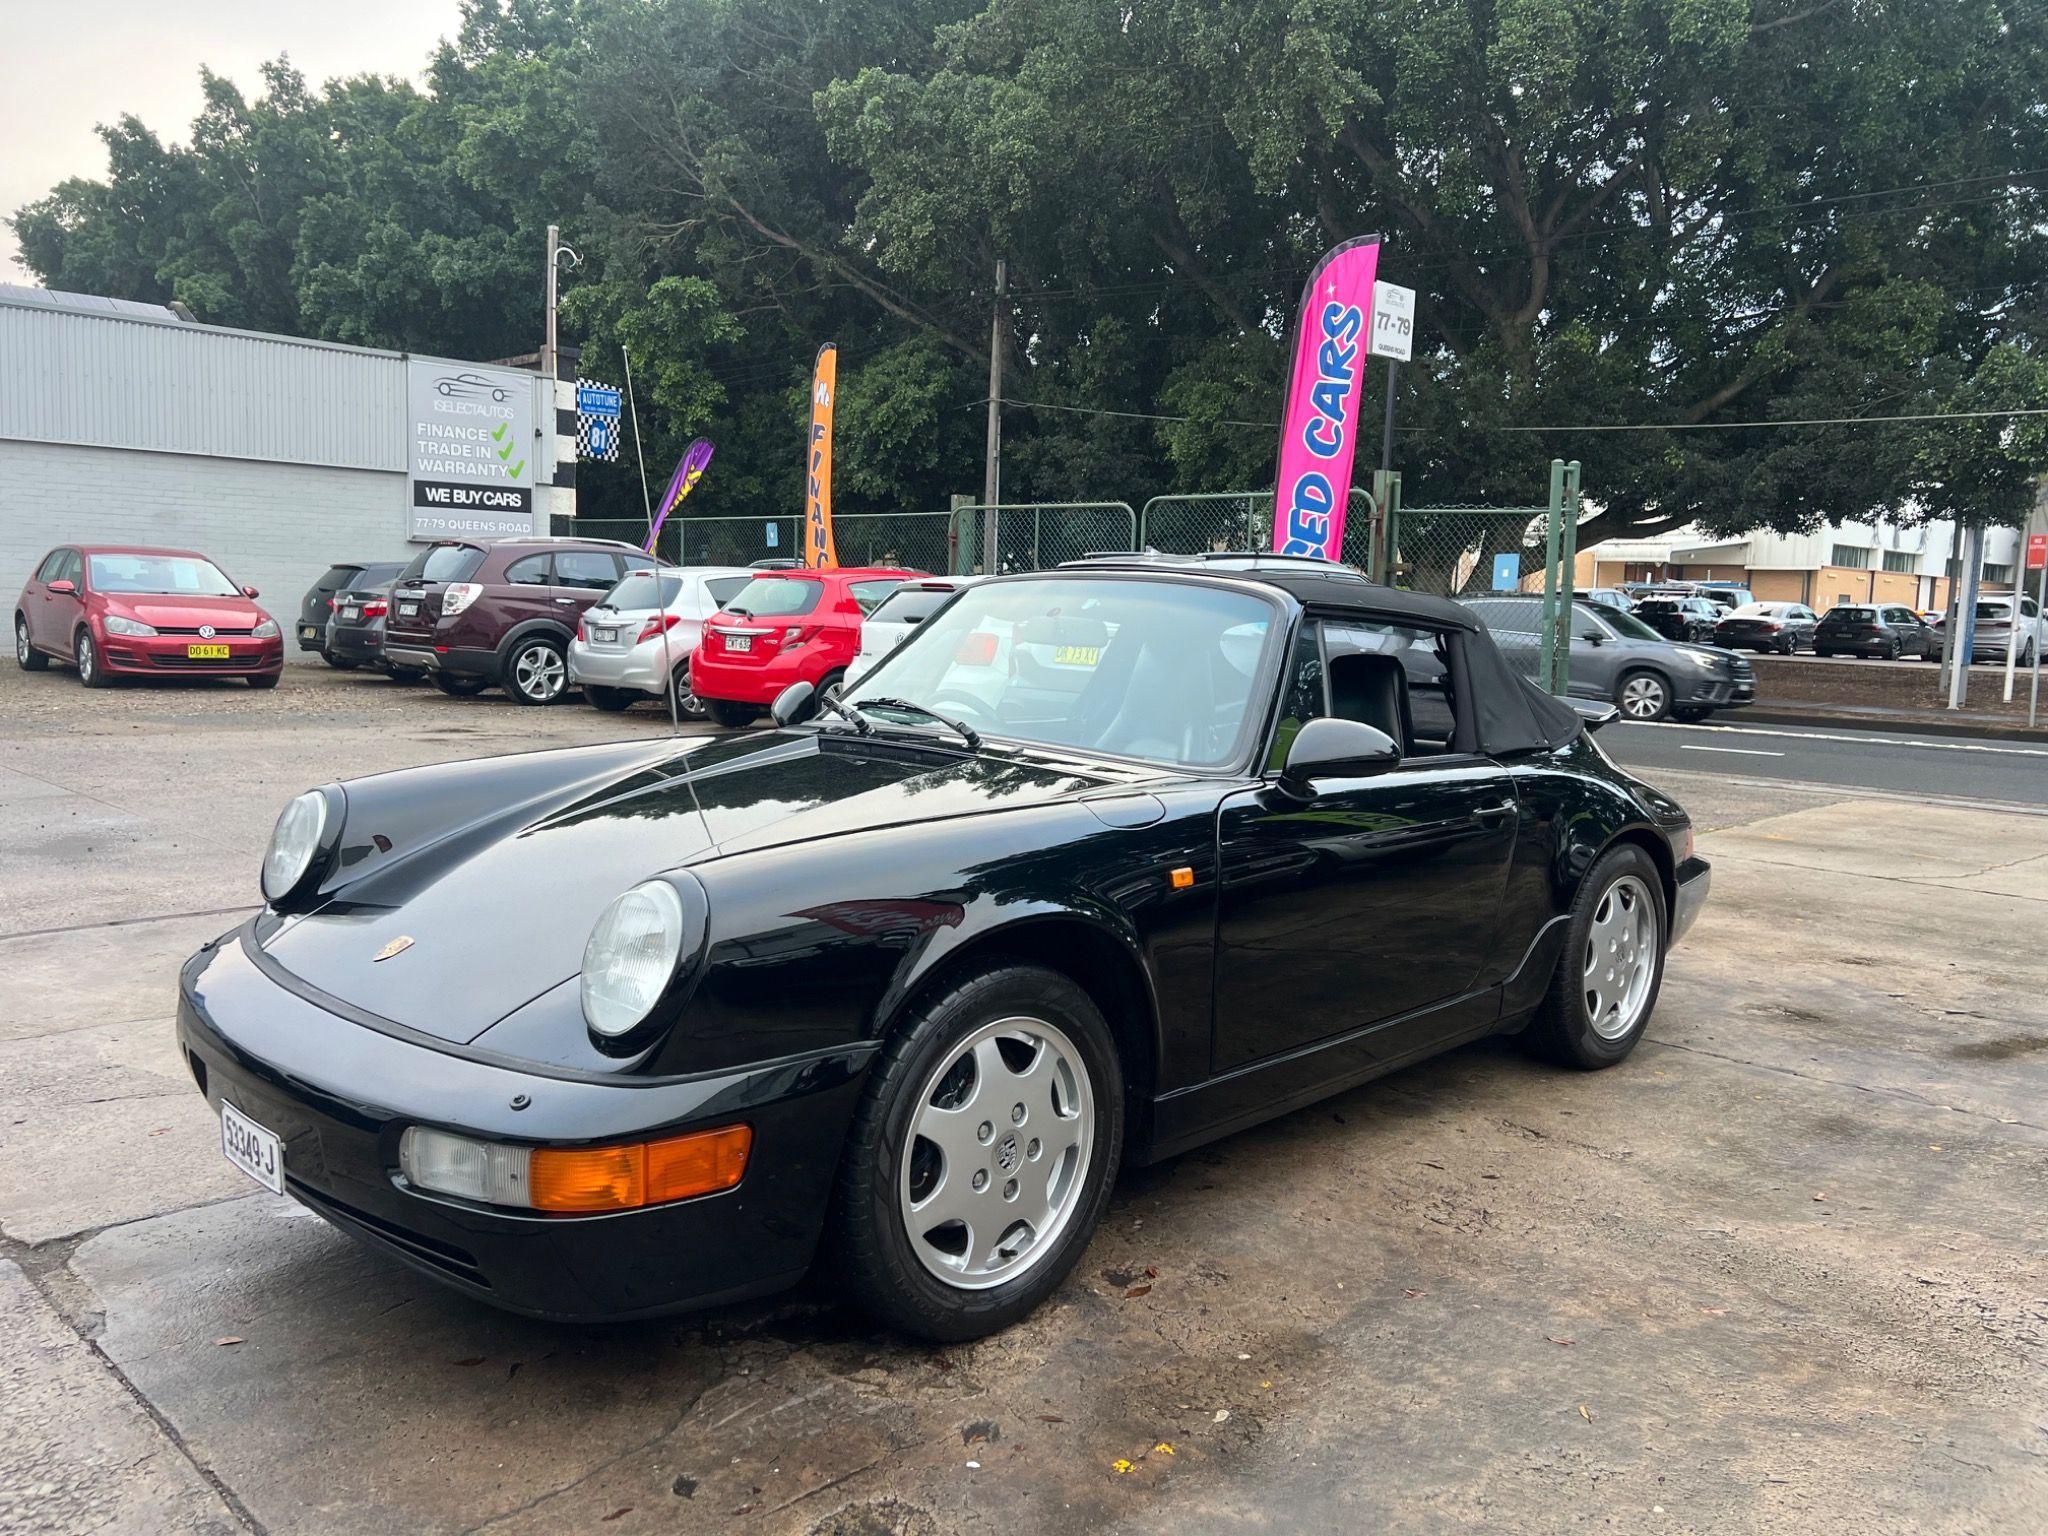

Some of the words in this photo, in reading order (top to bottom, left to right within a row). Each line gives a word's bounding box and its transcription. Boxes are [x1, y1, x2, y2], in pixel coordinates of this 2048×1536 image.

[1303, 301, 1362, 459] CARS
[582, 392, 618, 407] AUTOTUNE
[417, 422, 488, 441] FINANCE
[591, 427, 606, 450] 81
[417, 440, 473, 457] TRADE
[475, 446, 492, 459] IN
[417, 458, 509, 478] WARRANTY
[425, 487, 451, 503] WE
[453, 489, 483, 505] BUY
[483, 491, 522, 508] CARS
[415, 517, 446, 529] 77-79
[448, 519, 496, 532] QUEENS
[498, 521, 531, 533] ROAD
